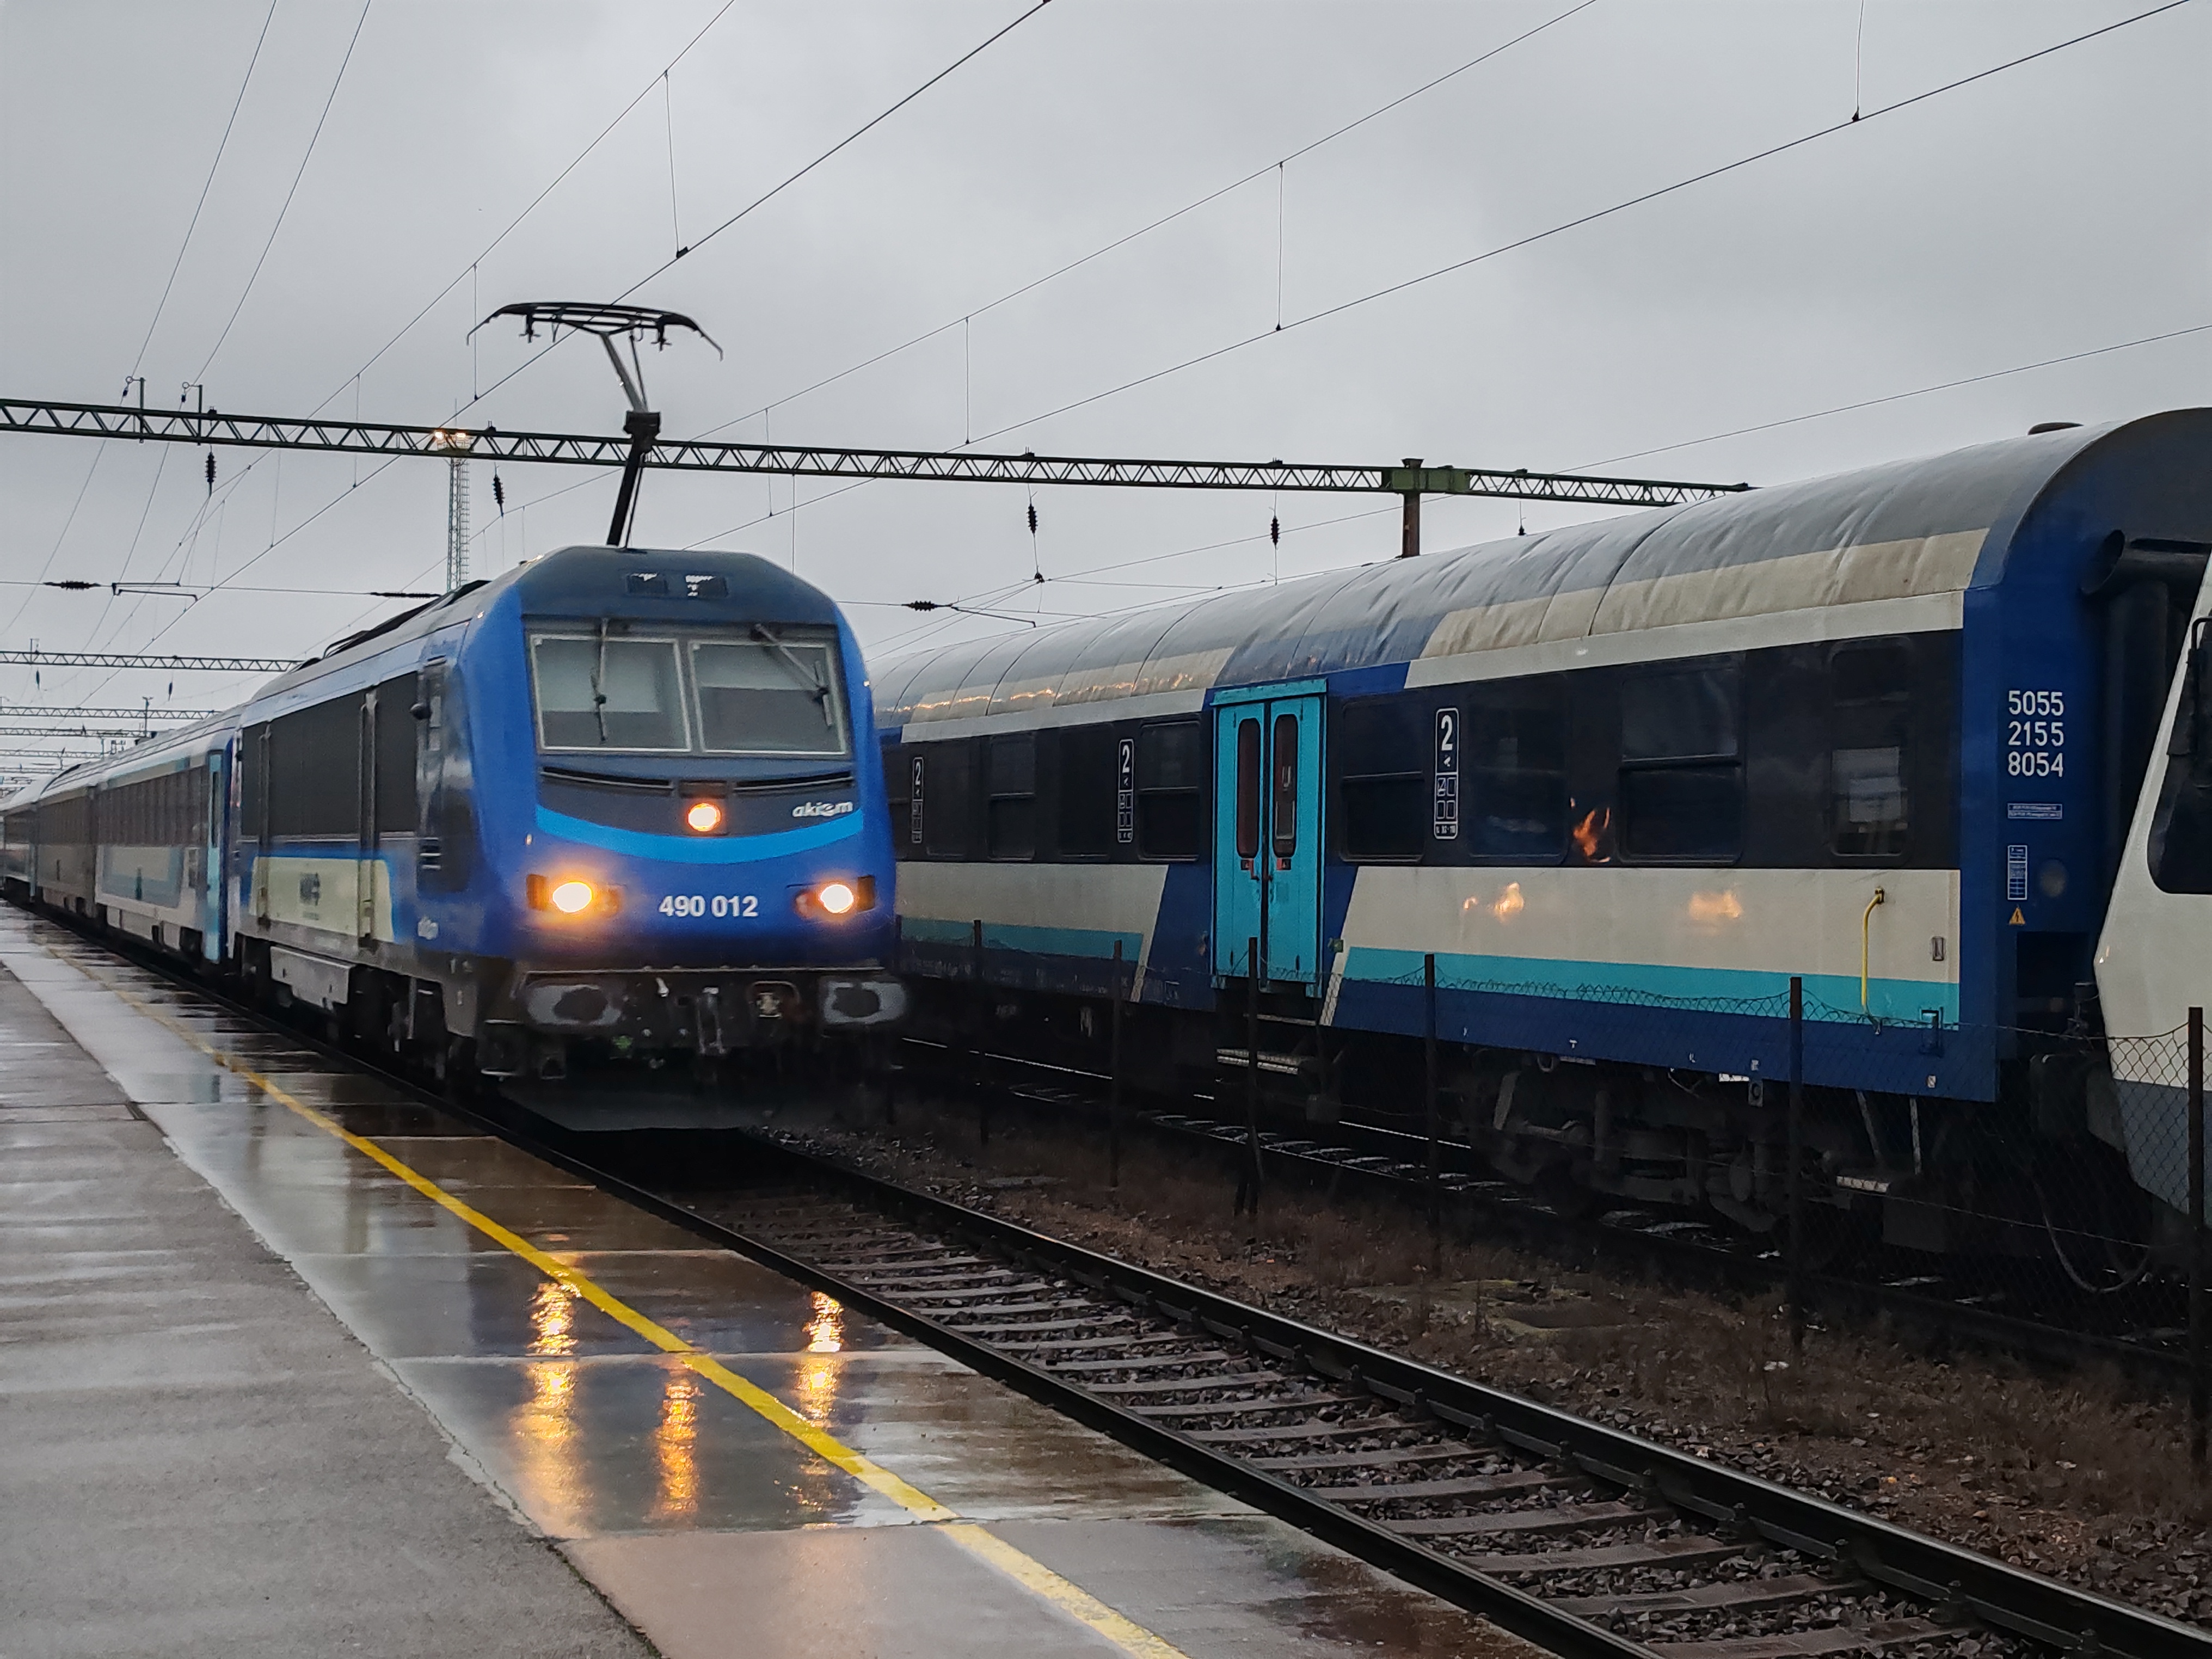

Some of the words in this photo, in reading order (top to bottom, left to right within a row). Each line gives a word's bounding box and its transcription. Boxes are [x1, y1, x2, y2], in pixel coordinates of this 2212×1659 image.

[2008, 690, 2064, 716] 5055
[1441, 714, 1453, 751] 2
[2008, 721, 2064, 747] 2155
[1122, 745, 1130, 773] 2
[2008, 751, 2064, 778] 8054
[915, 761, 921, 785] 2
[659, 895, 706, 917] 490
[711, 895, 759, 917] 012
